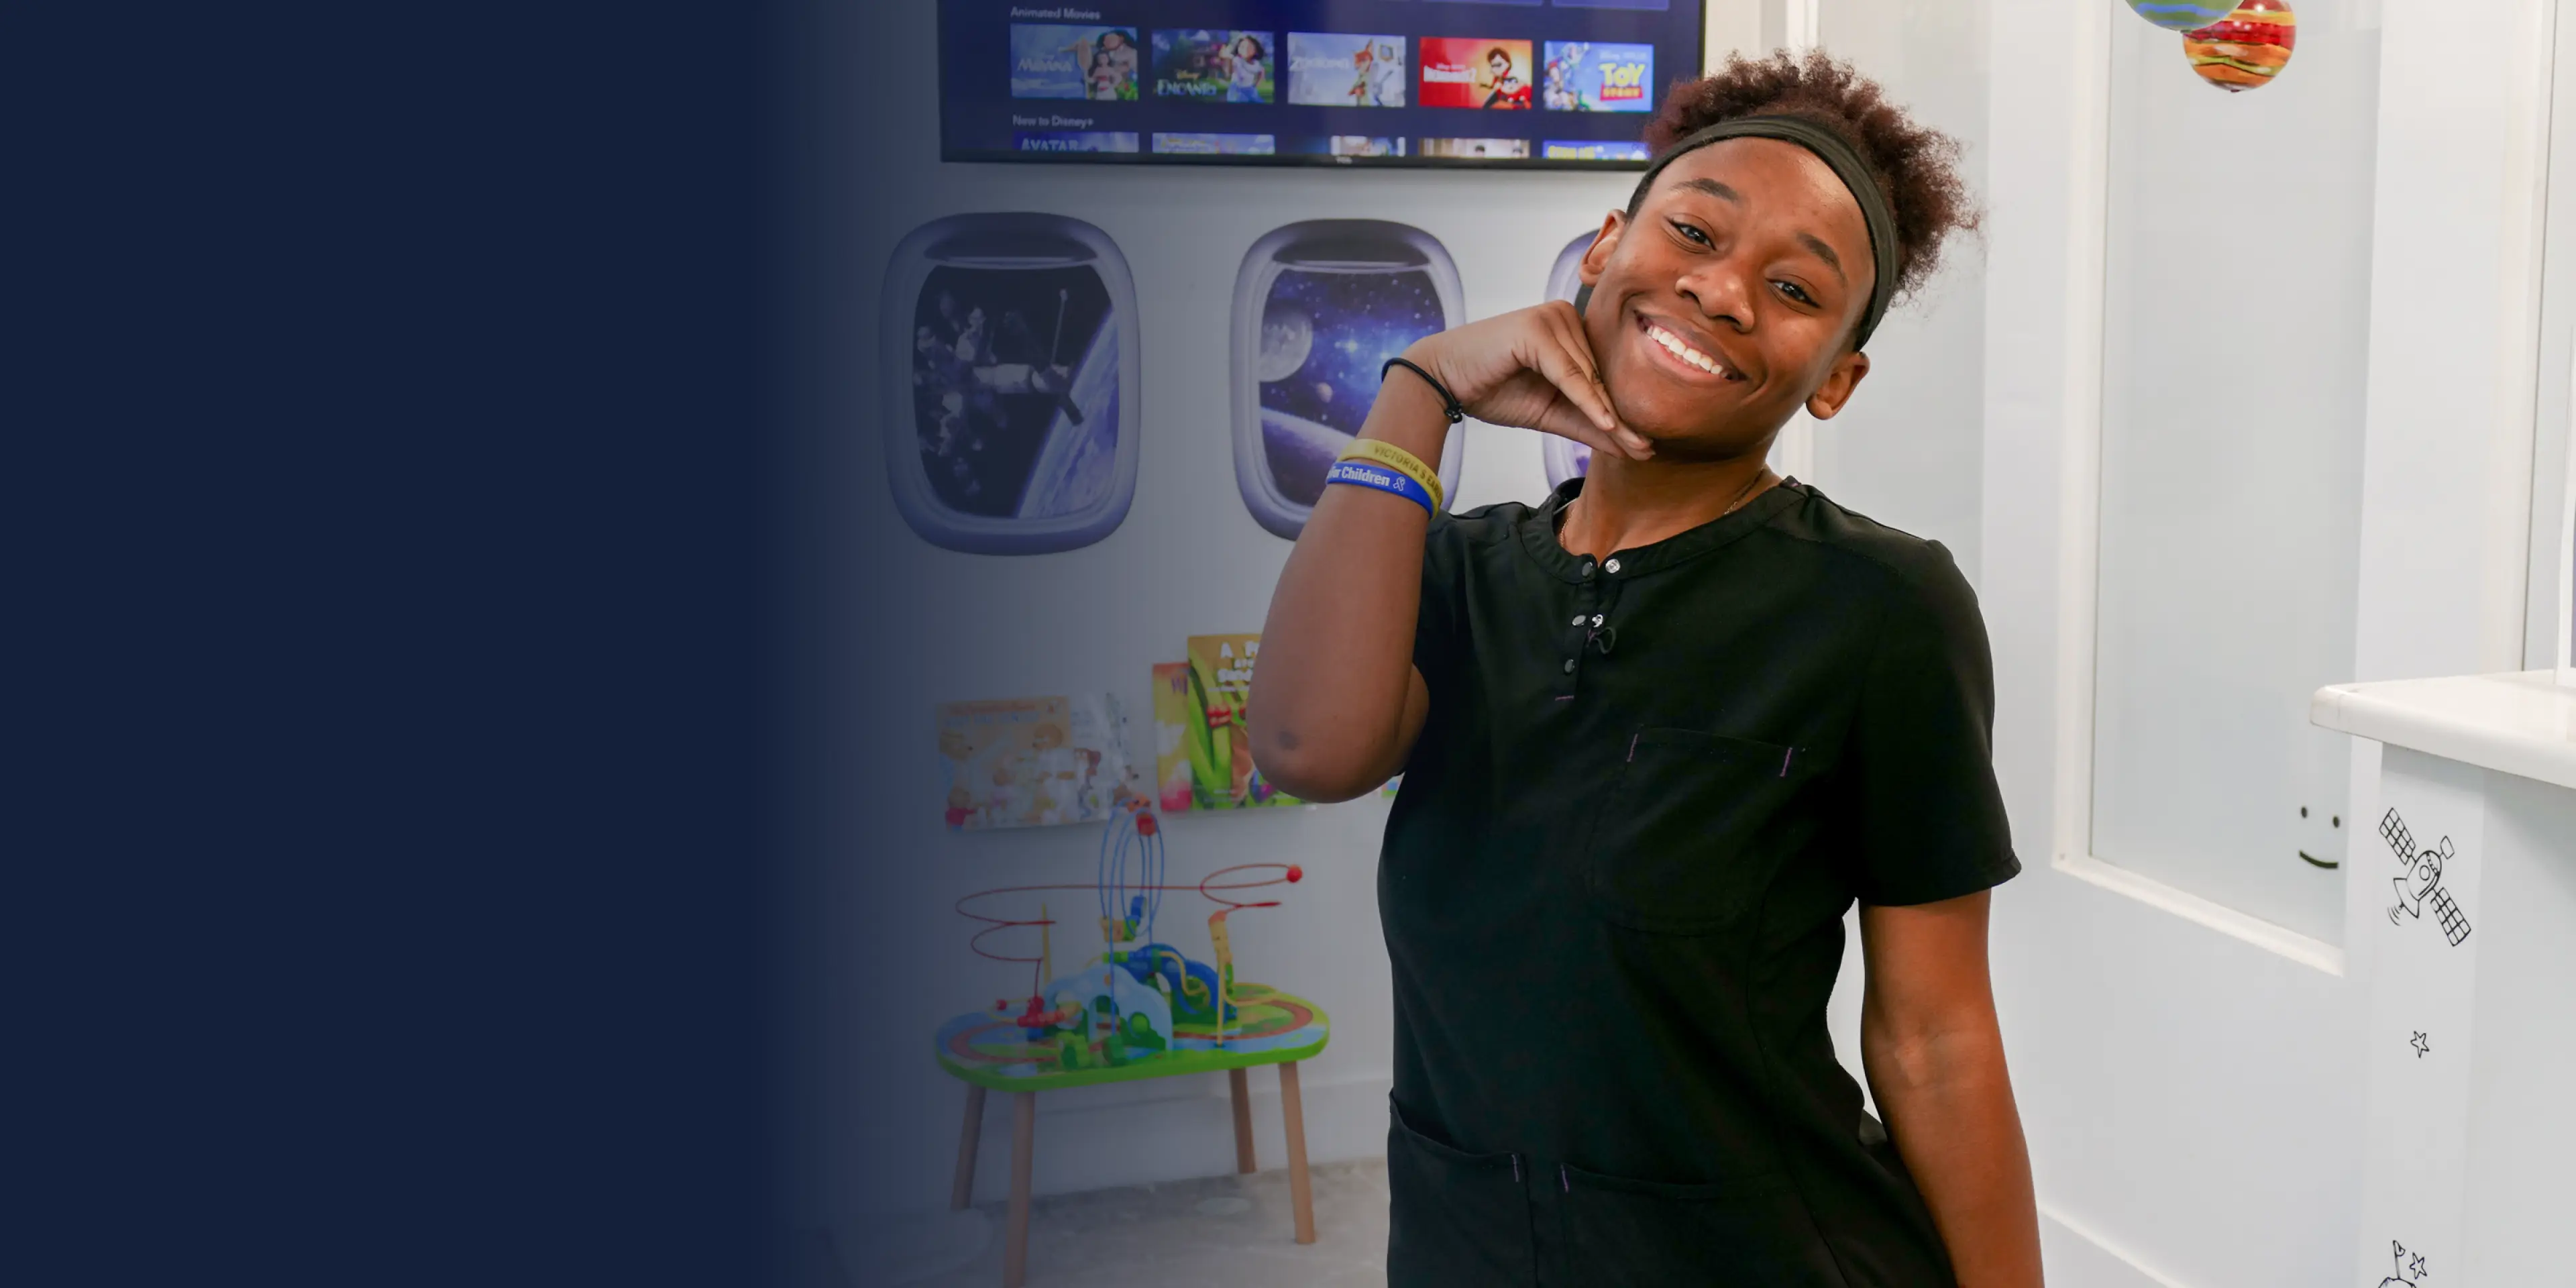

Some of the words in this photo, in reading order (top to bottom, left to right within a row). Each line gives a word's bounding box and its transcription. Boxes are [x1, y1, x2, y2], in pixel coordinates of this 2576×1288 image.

[1011, 7, 1061, 19] Animated
[1063, 8, 1101, 20] Movies
[1599, 62, 1646, 87] TOY
[1012, 115, 1036, 126] New
[1038, 115, 1049, 126] to
[1051, 115, 1095, 129] Disney+
[1021, 138, 1079, 152] AVATAR
[1375, 445, 1419, 474] VICTORIA
[1342, 466, 1391, 486] Children
